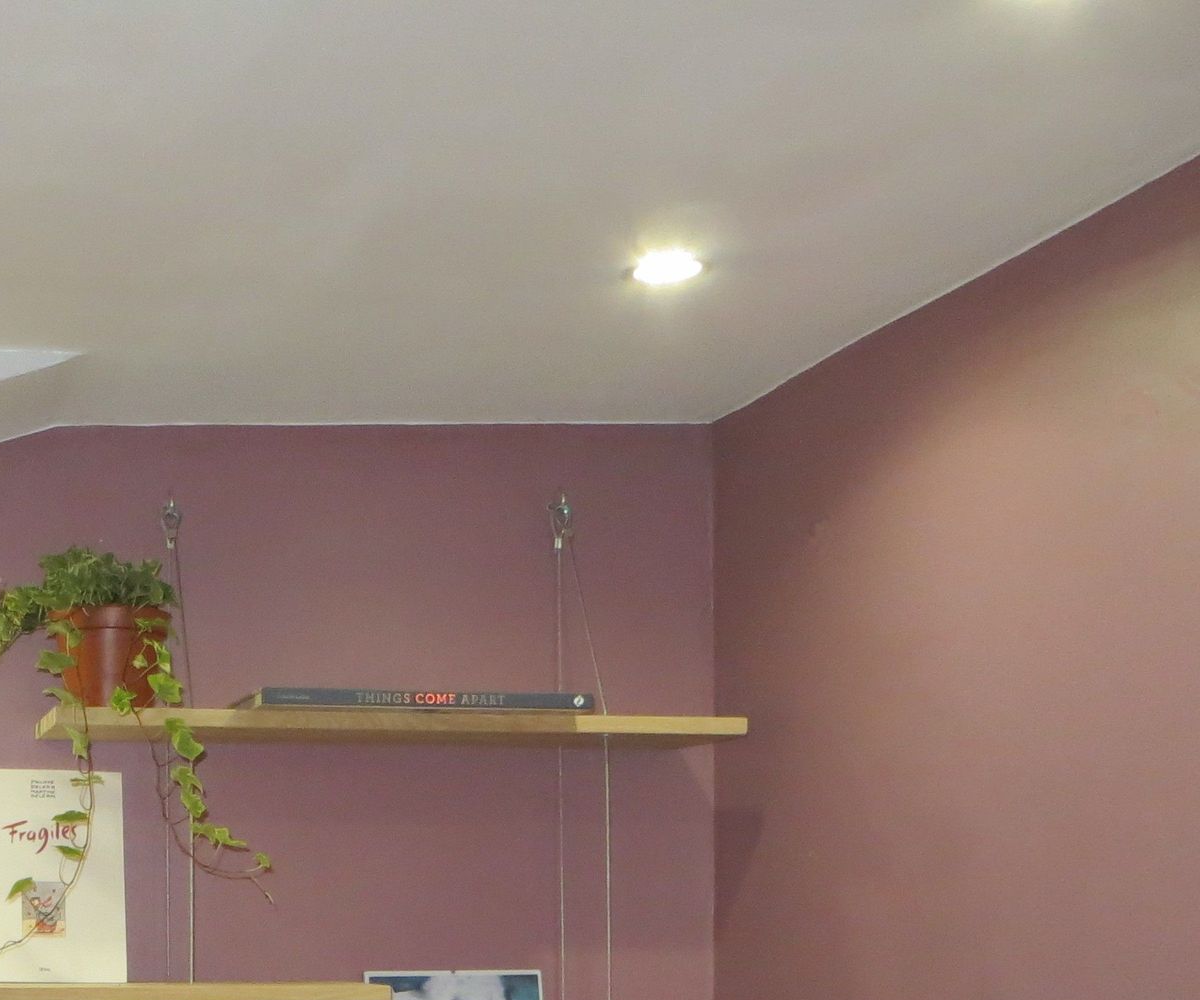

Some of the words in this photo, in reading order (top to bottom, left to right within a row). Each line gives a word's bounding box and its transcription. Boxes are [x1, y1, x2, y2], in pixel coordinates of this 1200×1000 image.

[356, 691, 410, 704] THINGS
[415, 692, 457, 705] COME
[461, 693, 505, 706] APART
[2, 819, 77, 854] Fragiles
